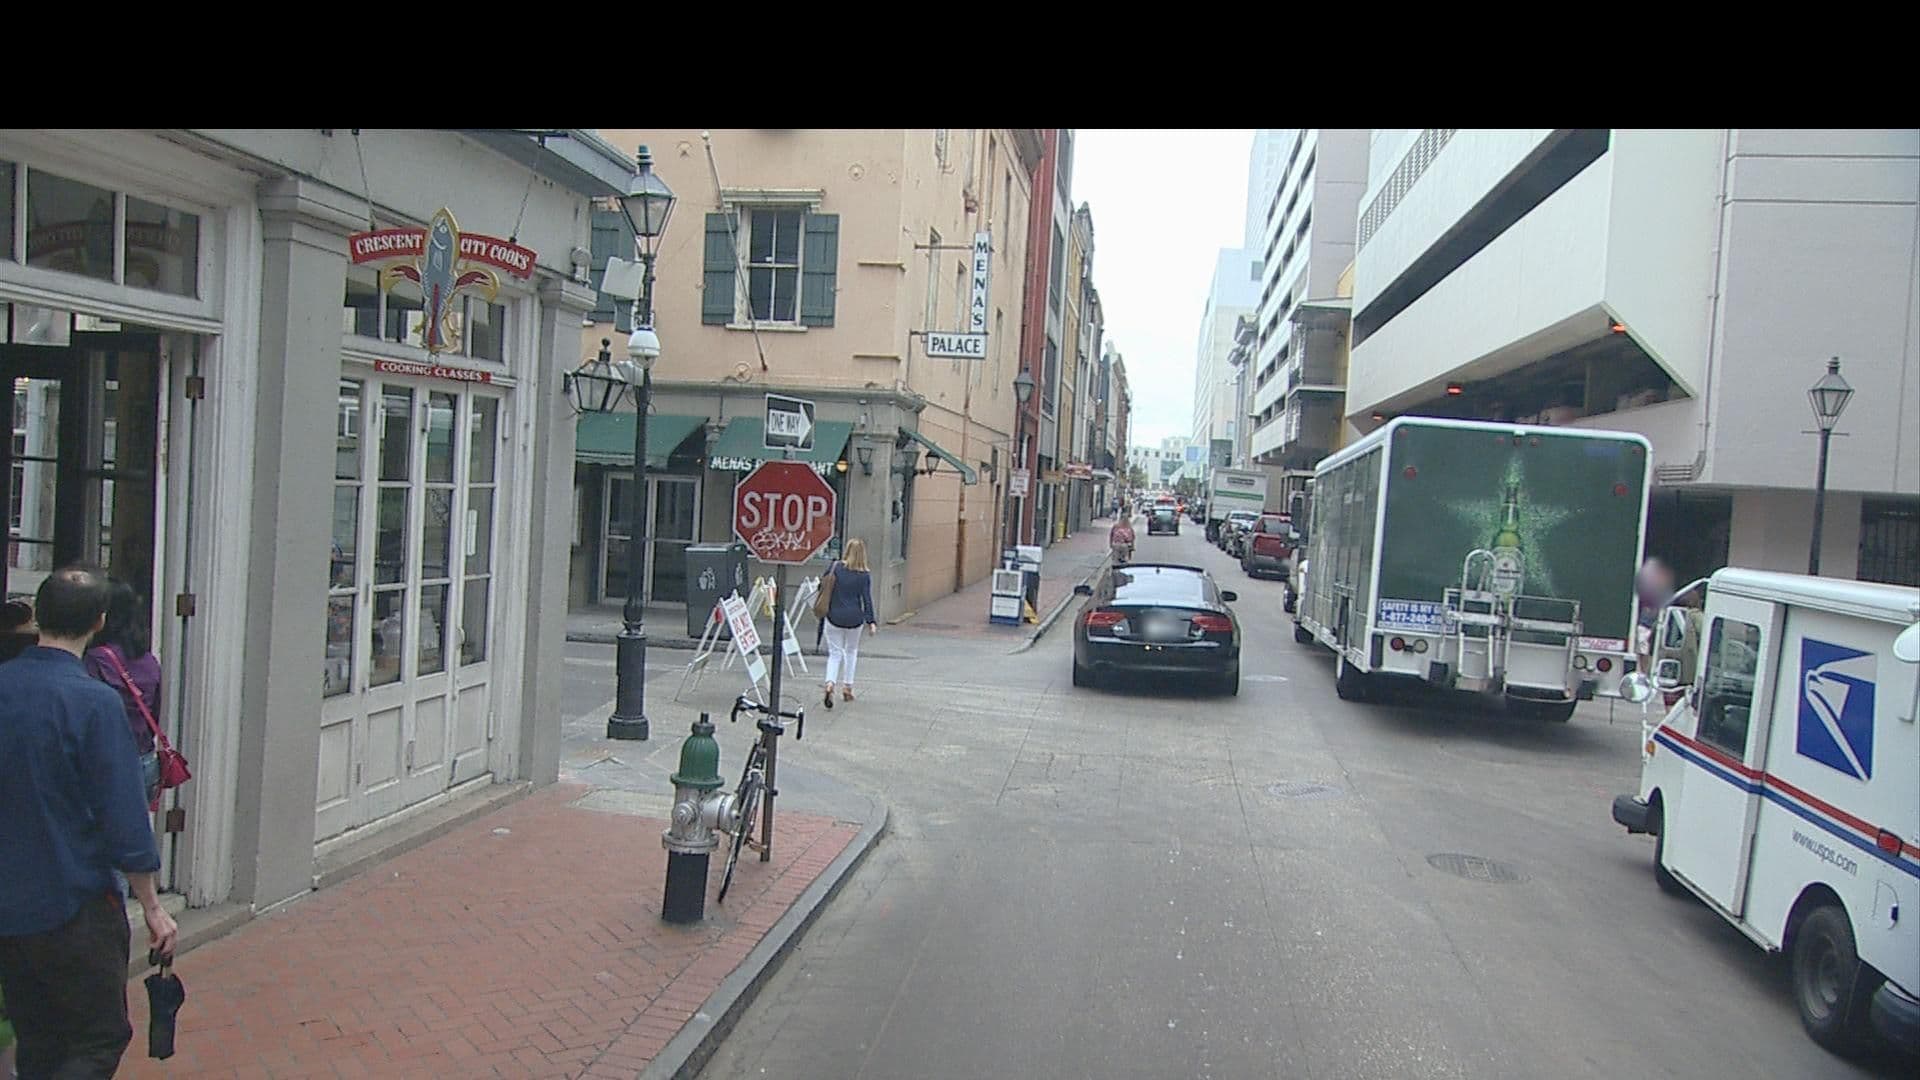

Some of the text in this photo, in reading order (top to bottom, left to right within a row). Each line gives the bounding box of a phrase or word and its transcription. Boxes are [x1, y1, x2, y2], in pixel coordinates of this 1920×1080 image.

[356, 234, 530, 270] CRESCENT CITY COOKS
[931, 336, 982, 354] PALACE
[381, 362, 483, 382] COOKING CLASSES
[771, 412, 801, 433] ONE WAY
[741, 491, 828, 532] STOP
[1382, 601, 1410, 612] SAFETY
[1410, 603, 1419, 613] IS
[1792, 831, 1858, 877] www.usps.com
